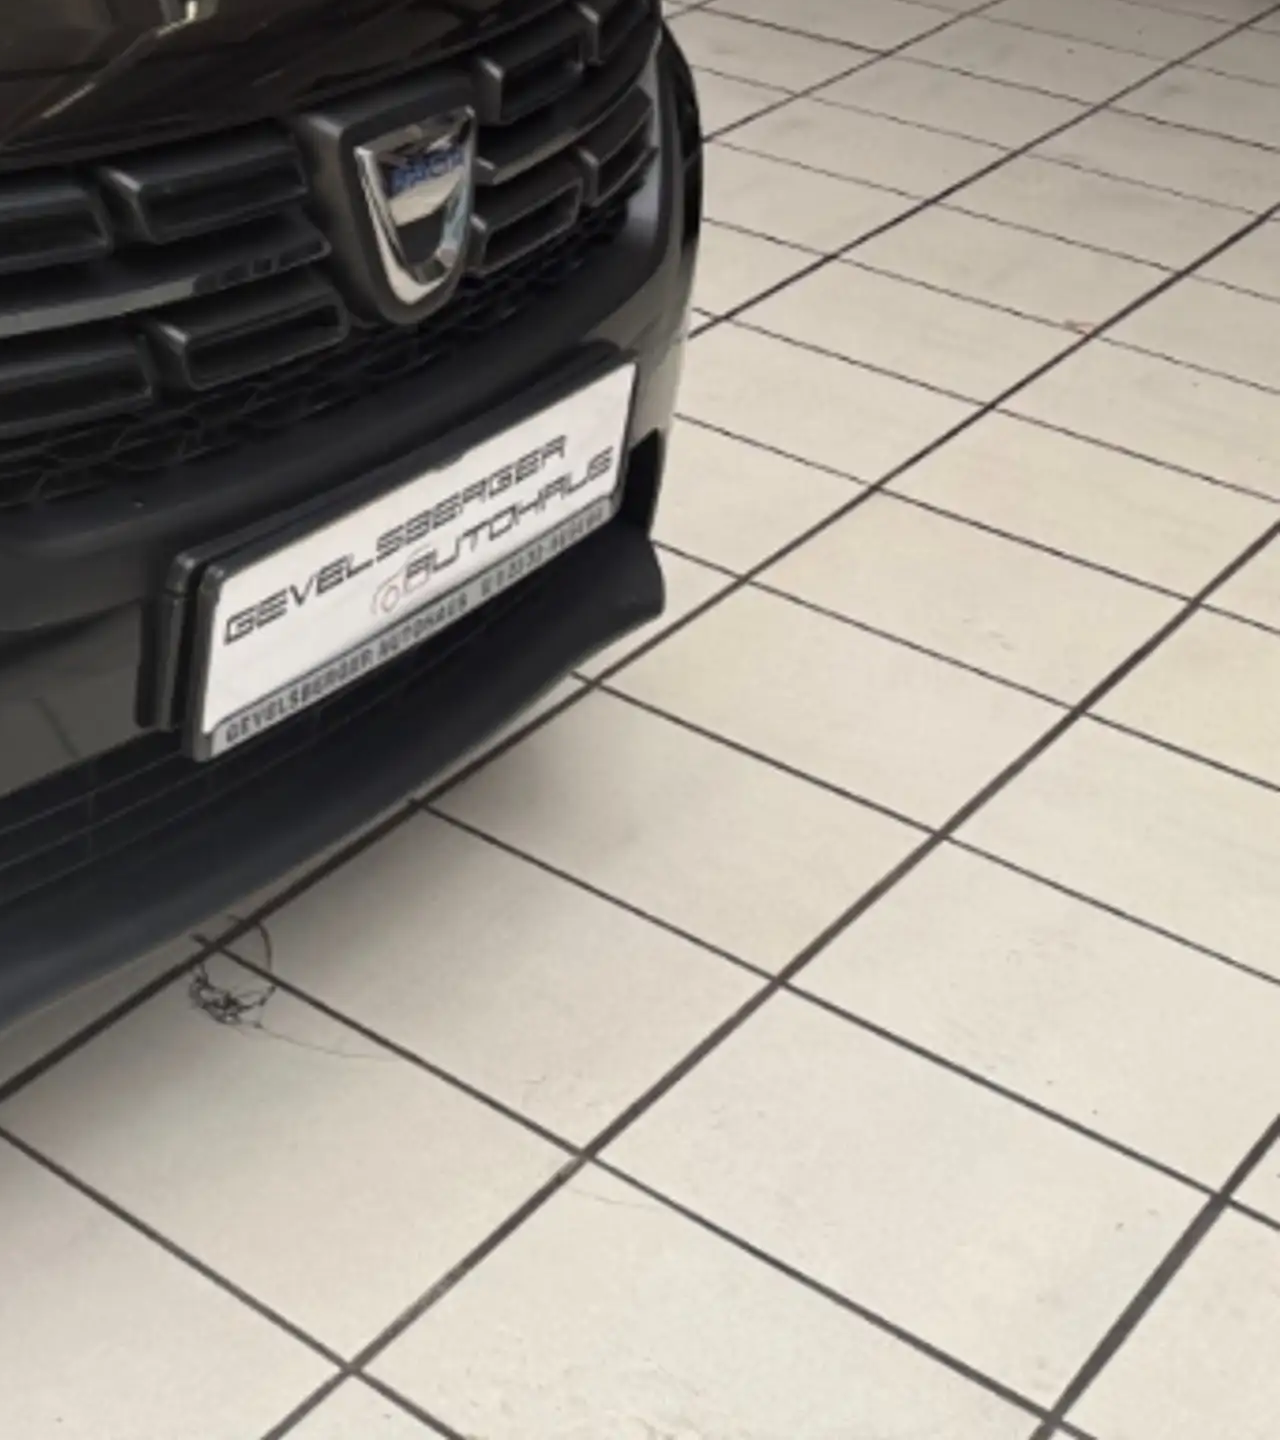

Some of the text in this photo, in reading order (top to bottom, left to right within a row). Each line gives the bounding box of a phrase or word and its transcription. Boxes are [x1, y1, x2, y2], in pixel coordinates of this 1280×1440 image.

[223, 434, 567, 645] GEVELSBERGER
[405, 445, 615, 581] AUTOHAUS
[225, 648, 375, 744] GEVELSBERGER
